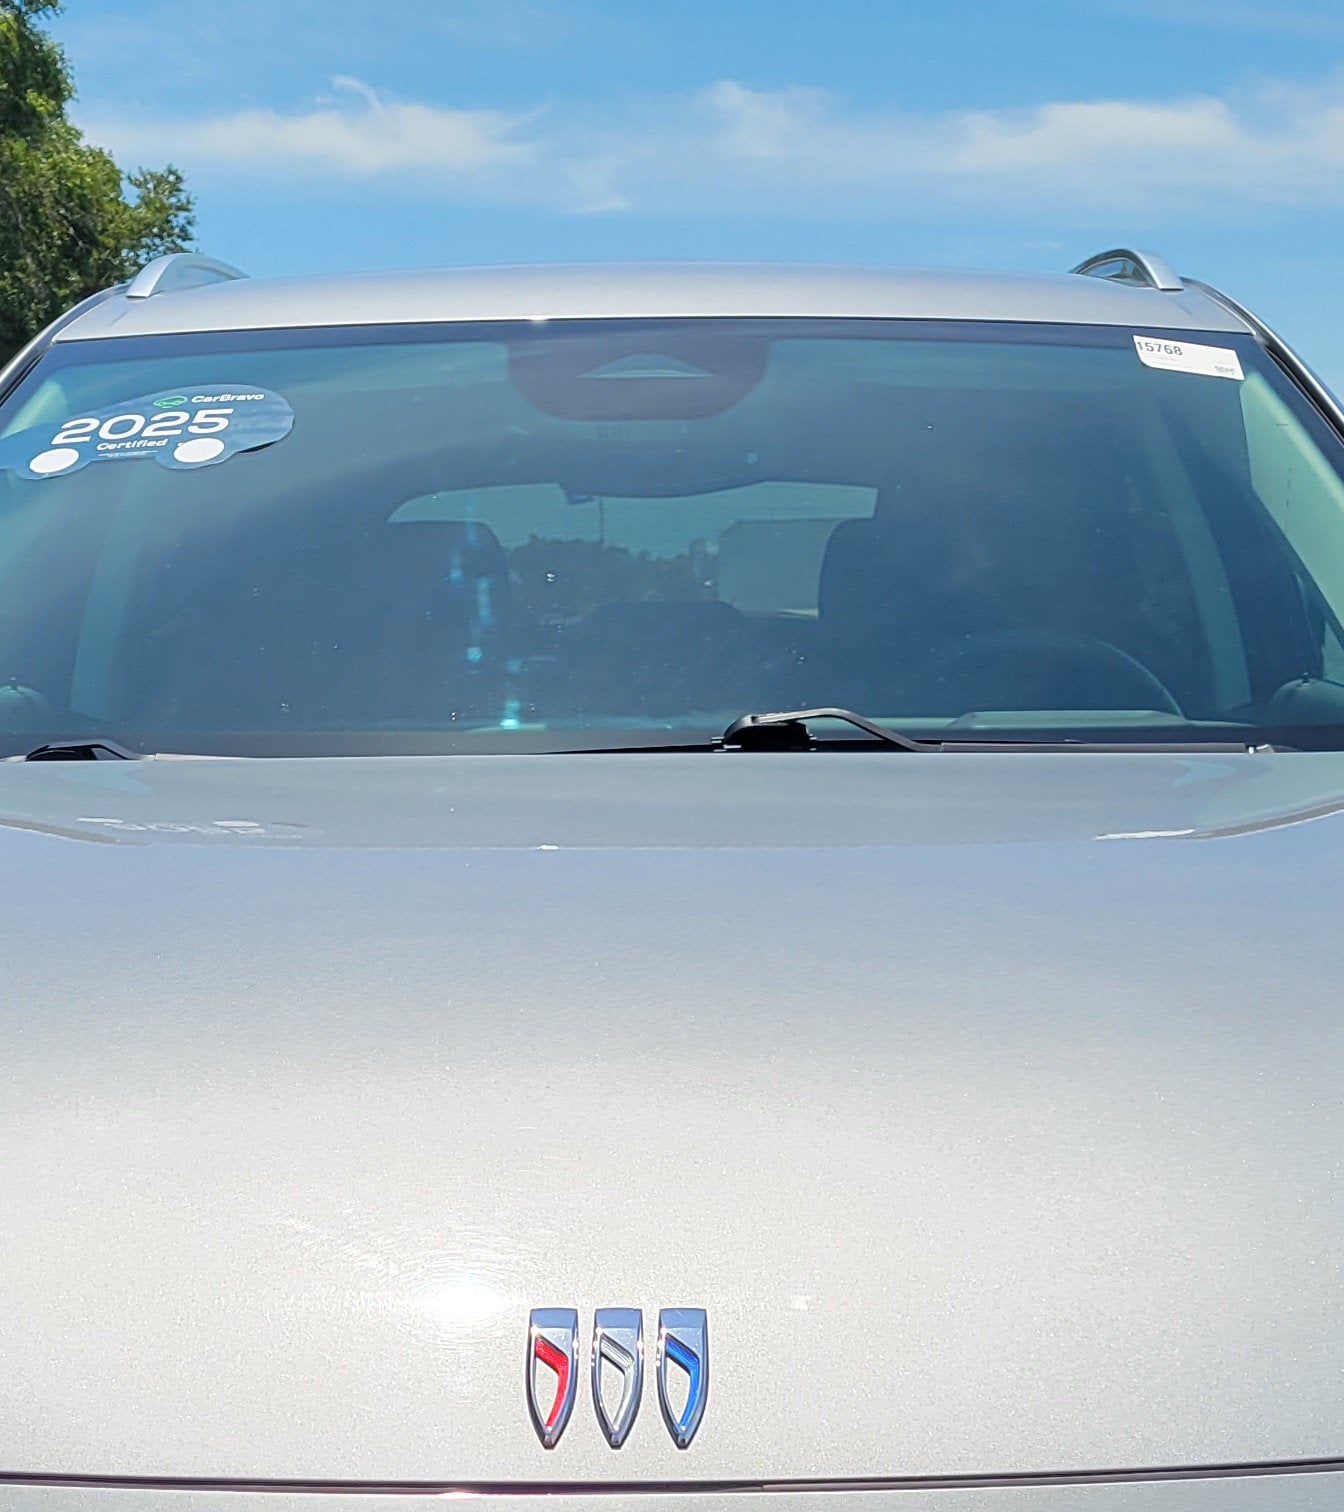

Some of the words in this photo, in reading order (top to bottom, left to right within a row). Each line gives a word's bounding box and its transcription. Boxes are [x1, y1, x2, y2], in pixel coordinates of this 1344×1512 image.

[1137, 341, 1183, 356] 15768
[191, 393, 265, 403] CarBravo
[50, 408, 234, 445] 2025
[96, 439, 169, 451] Certified
